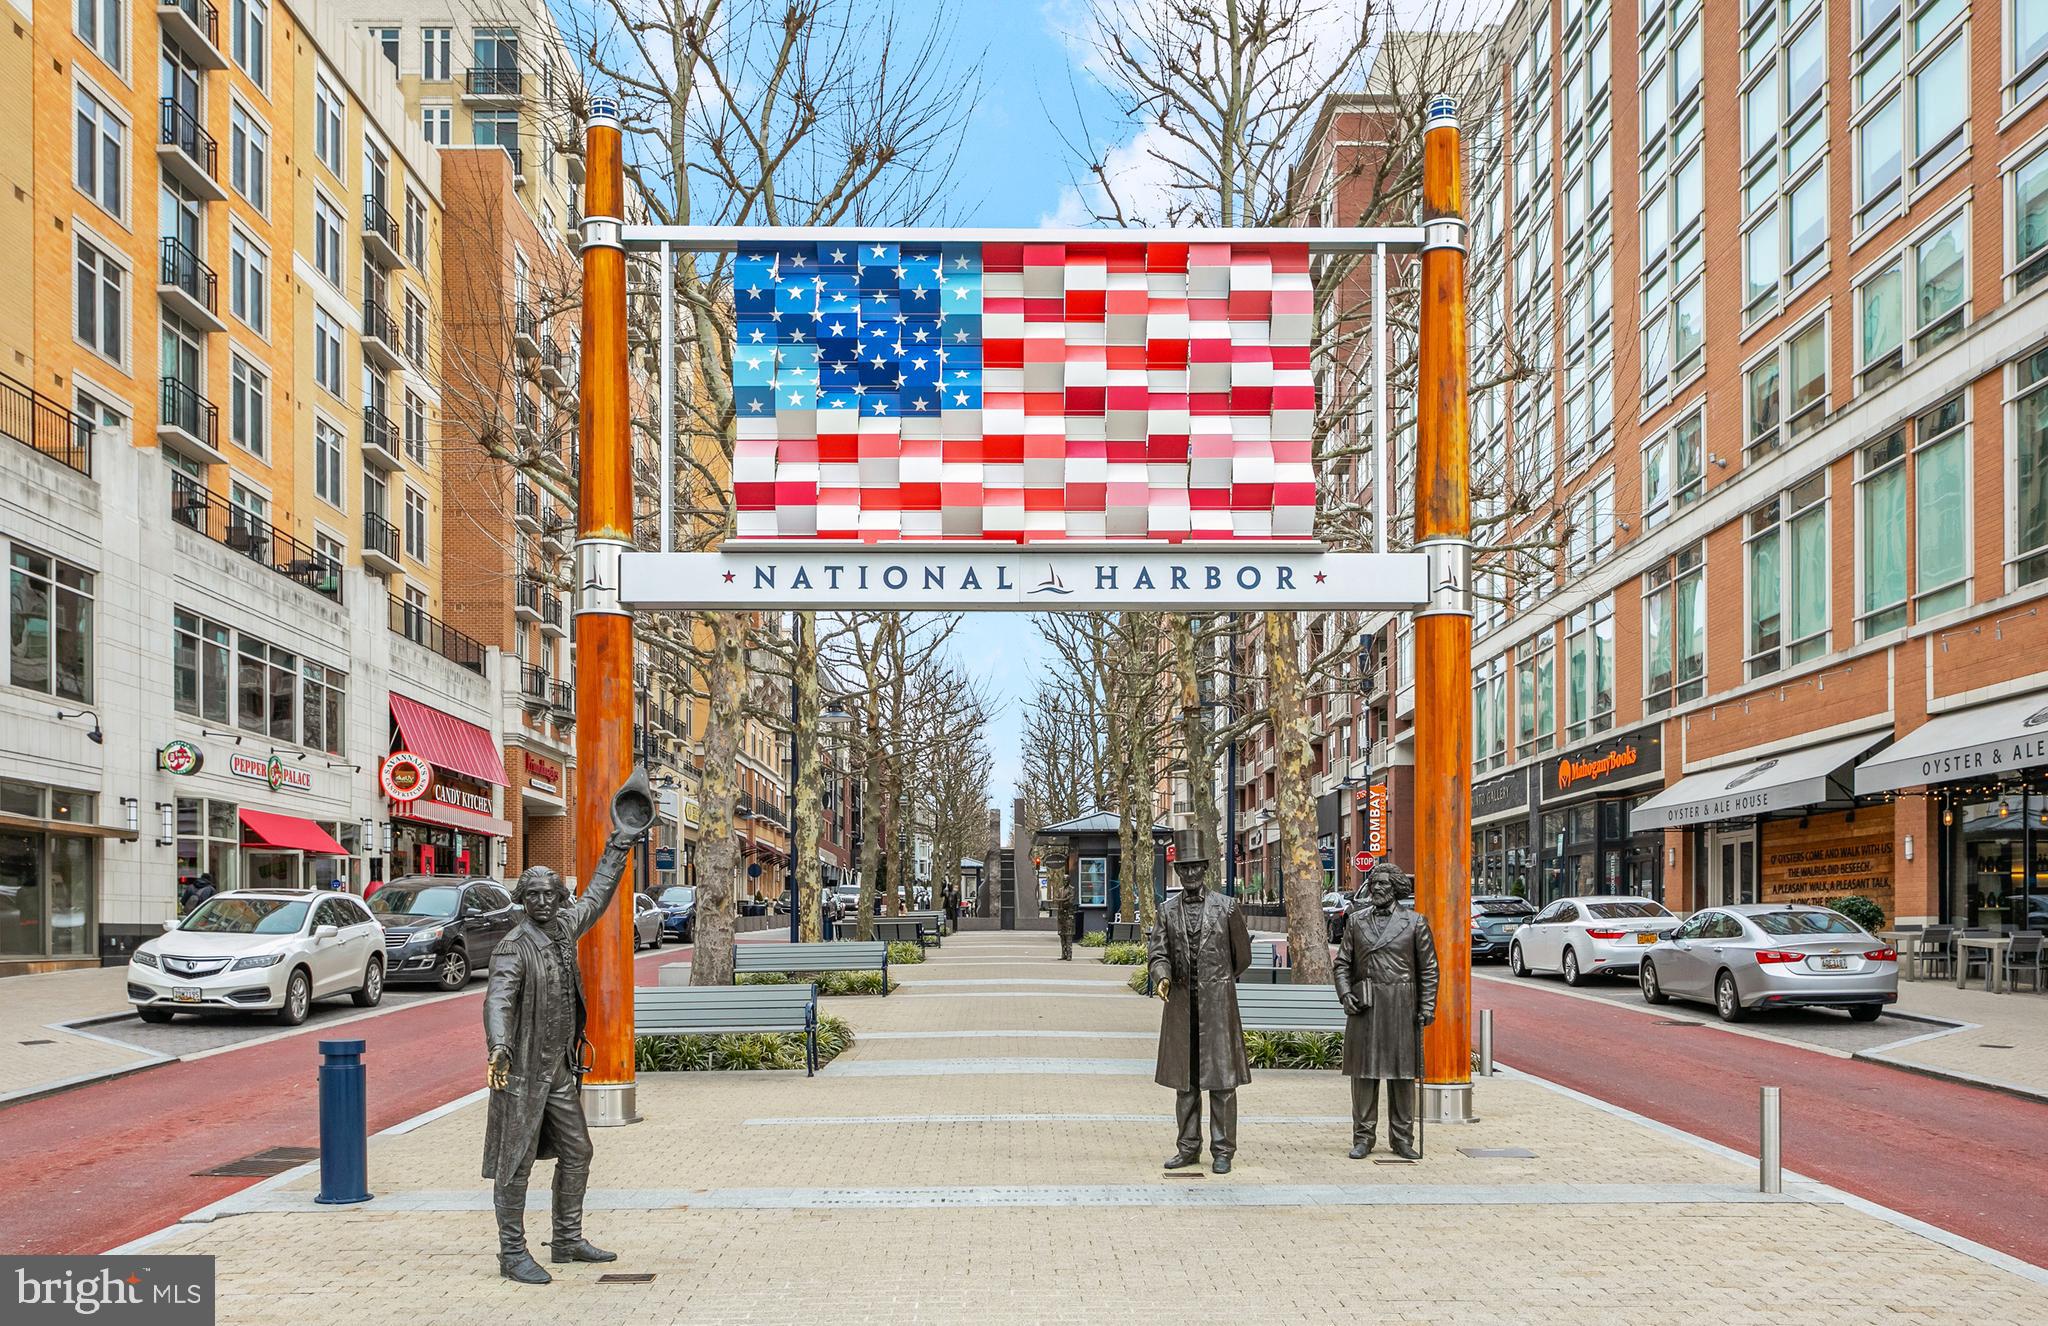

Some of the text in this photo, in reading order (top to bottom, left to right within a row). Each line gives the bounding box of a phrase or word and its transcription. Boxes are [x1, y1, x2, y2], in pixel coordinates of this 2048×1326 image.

[753, 565, 1297, 590] NATIONAL HARBOR
[1571, 744, 1638, 781] MahoganyBooks
[1922, 740, 2046, 776] OYSTER & ALE
[233, 756, 312, 788] PEPPER PALACE
[435, 784, 494, 814] CANDY KITCHEN
[1487, 785, 1511, 804] GALLERY
[1667, 793, 1769, 821] OYSTER & ALE HOUSE
[1369, 790, 1381, 852] BOMBAY
[1355, 857, 1374, 866] STOP
[1778, 851, 1806, 863] OYSTERS
[1805, 849, 1825, 862] COME
[1825, 848, 1840, 860] AND
[1840, 846, 1860, 857] WALK
[1861, 844, 1880, 856] WITH
[1788, 867, 1800, 878] THE
[1800, 865, 1827, 877] WALRUS
[1827, 864, 1840, 875] DID
[1772, 884, 1778, 895] A
[1777, 882, 1809, 894] PLEASANT
[1830, 880, 1836, 891] A
[1836, 878, 1870, 890] PLEASANT
